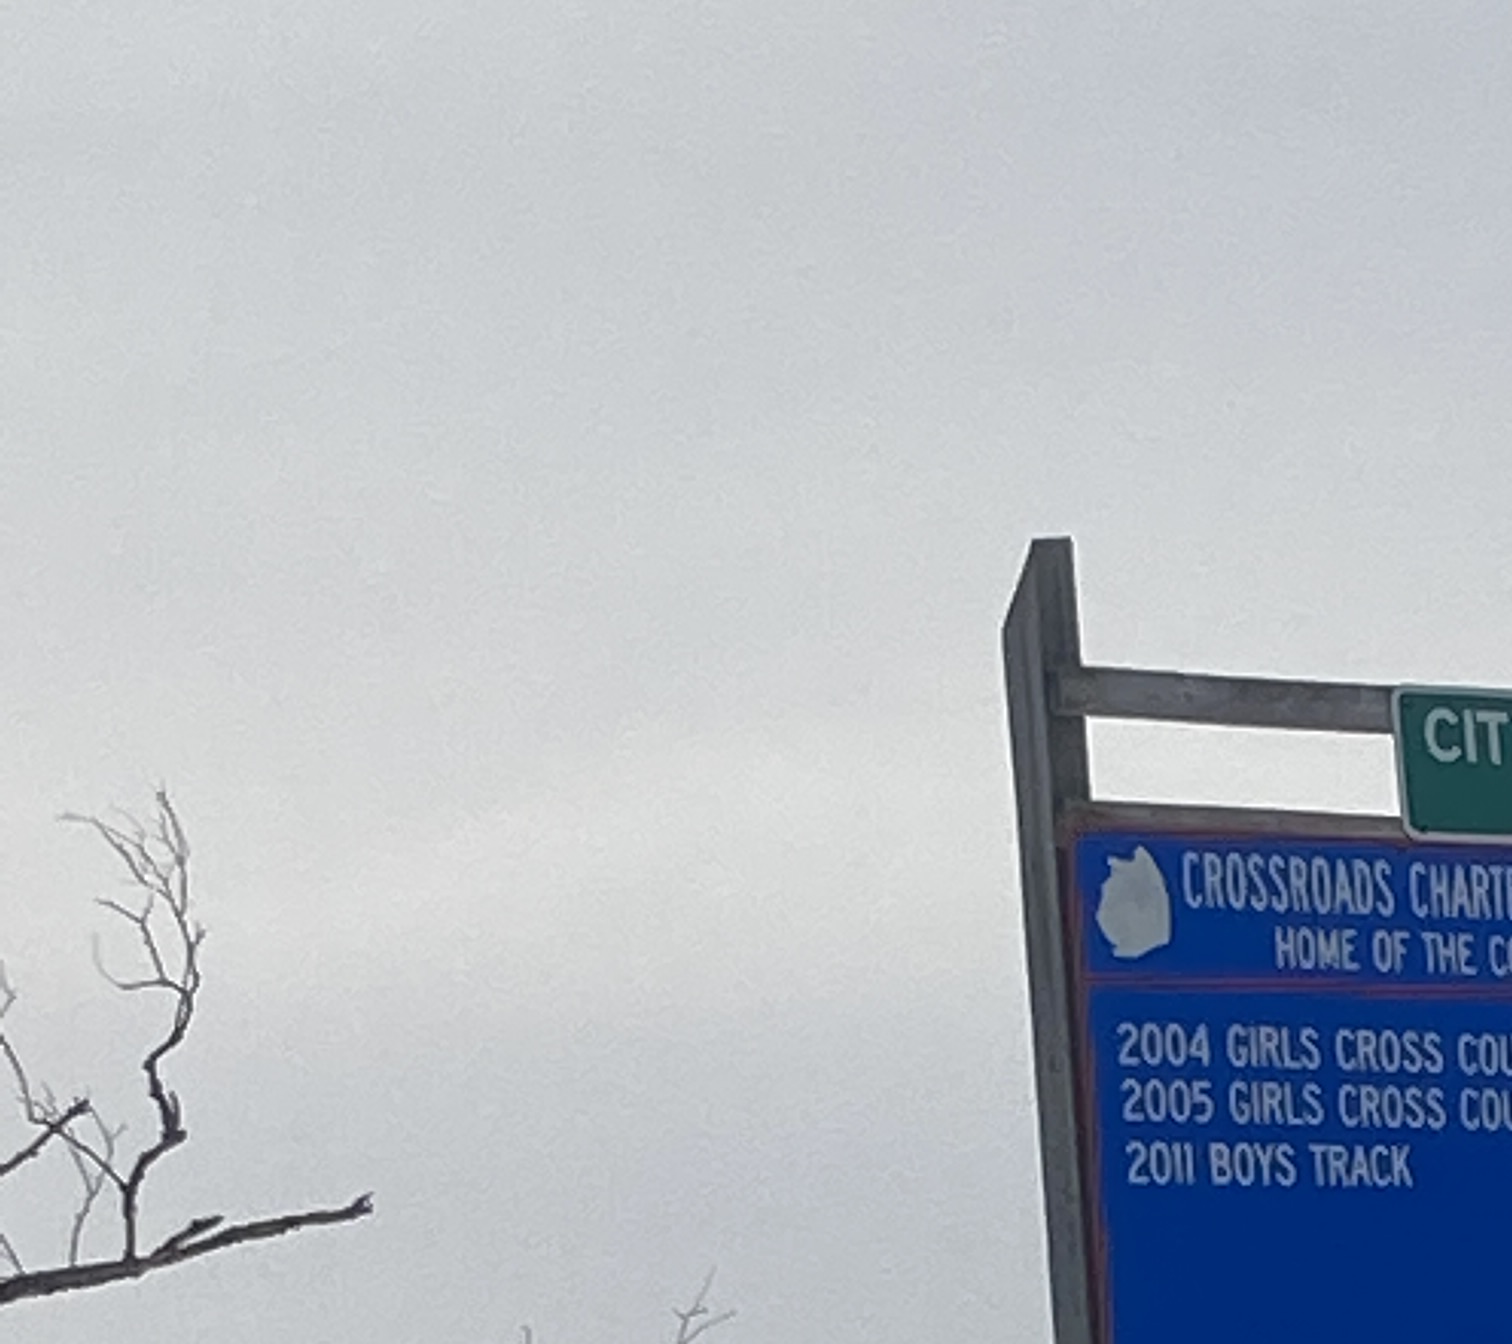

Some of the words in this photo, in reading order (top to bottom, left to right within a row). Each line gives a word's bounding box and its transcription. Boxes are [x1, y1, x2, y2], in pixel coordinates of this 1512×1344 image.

[1184, 851, 1394, 916] CROSSROADS
[1275, 927, 1360, 970] HOME
[1373, 930, 1410, 972] OF
[1421, 932, 1477, 975] THE
[1117, 1023, 1210, 1066] 2004
[1227, 1024, 1321, 1069] GIRLS
[1336, 1029, 1443, 1073] CROSS
[1122, 1078, 1213, 1123] 2005
[1229, 1080, 1324, 1125] GIRLS
[1339, 1084, 1446, 1129] CROSS
[1126, 1141, 1194, 1185] 2011
[1209, 1143, 1296, 1186] BOYS
[1309, 1144, 1412, 1186] TRACK
